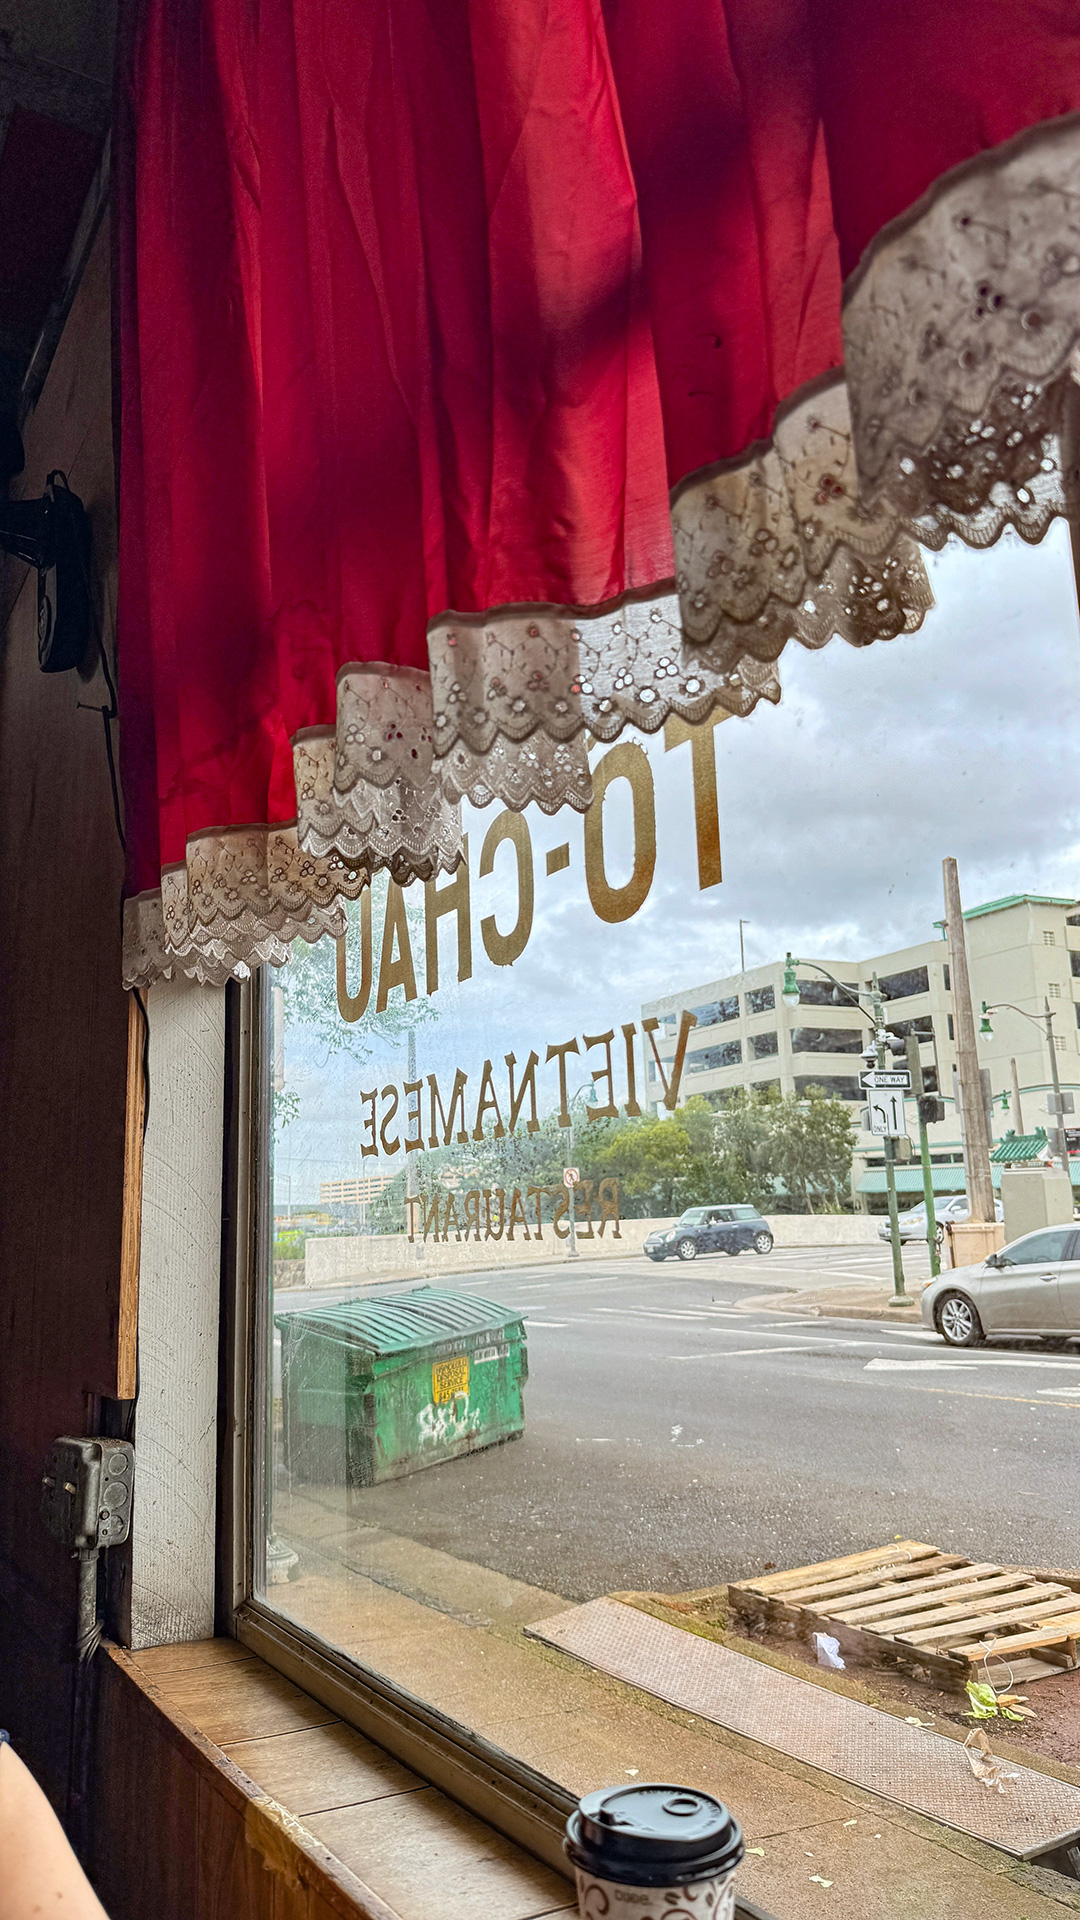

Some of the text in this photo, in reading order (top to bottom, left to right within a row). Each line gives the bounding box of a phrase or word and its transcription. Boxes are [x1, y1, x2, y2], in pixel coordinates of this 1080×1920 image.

[874, 1075, 905, 1083] ONE WAY
[873, 1125, 887, 1133] ONLY
